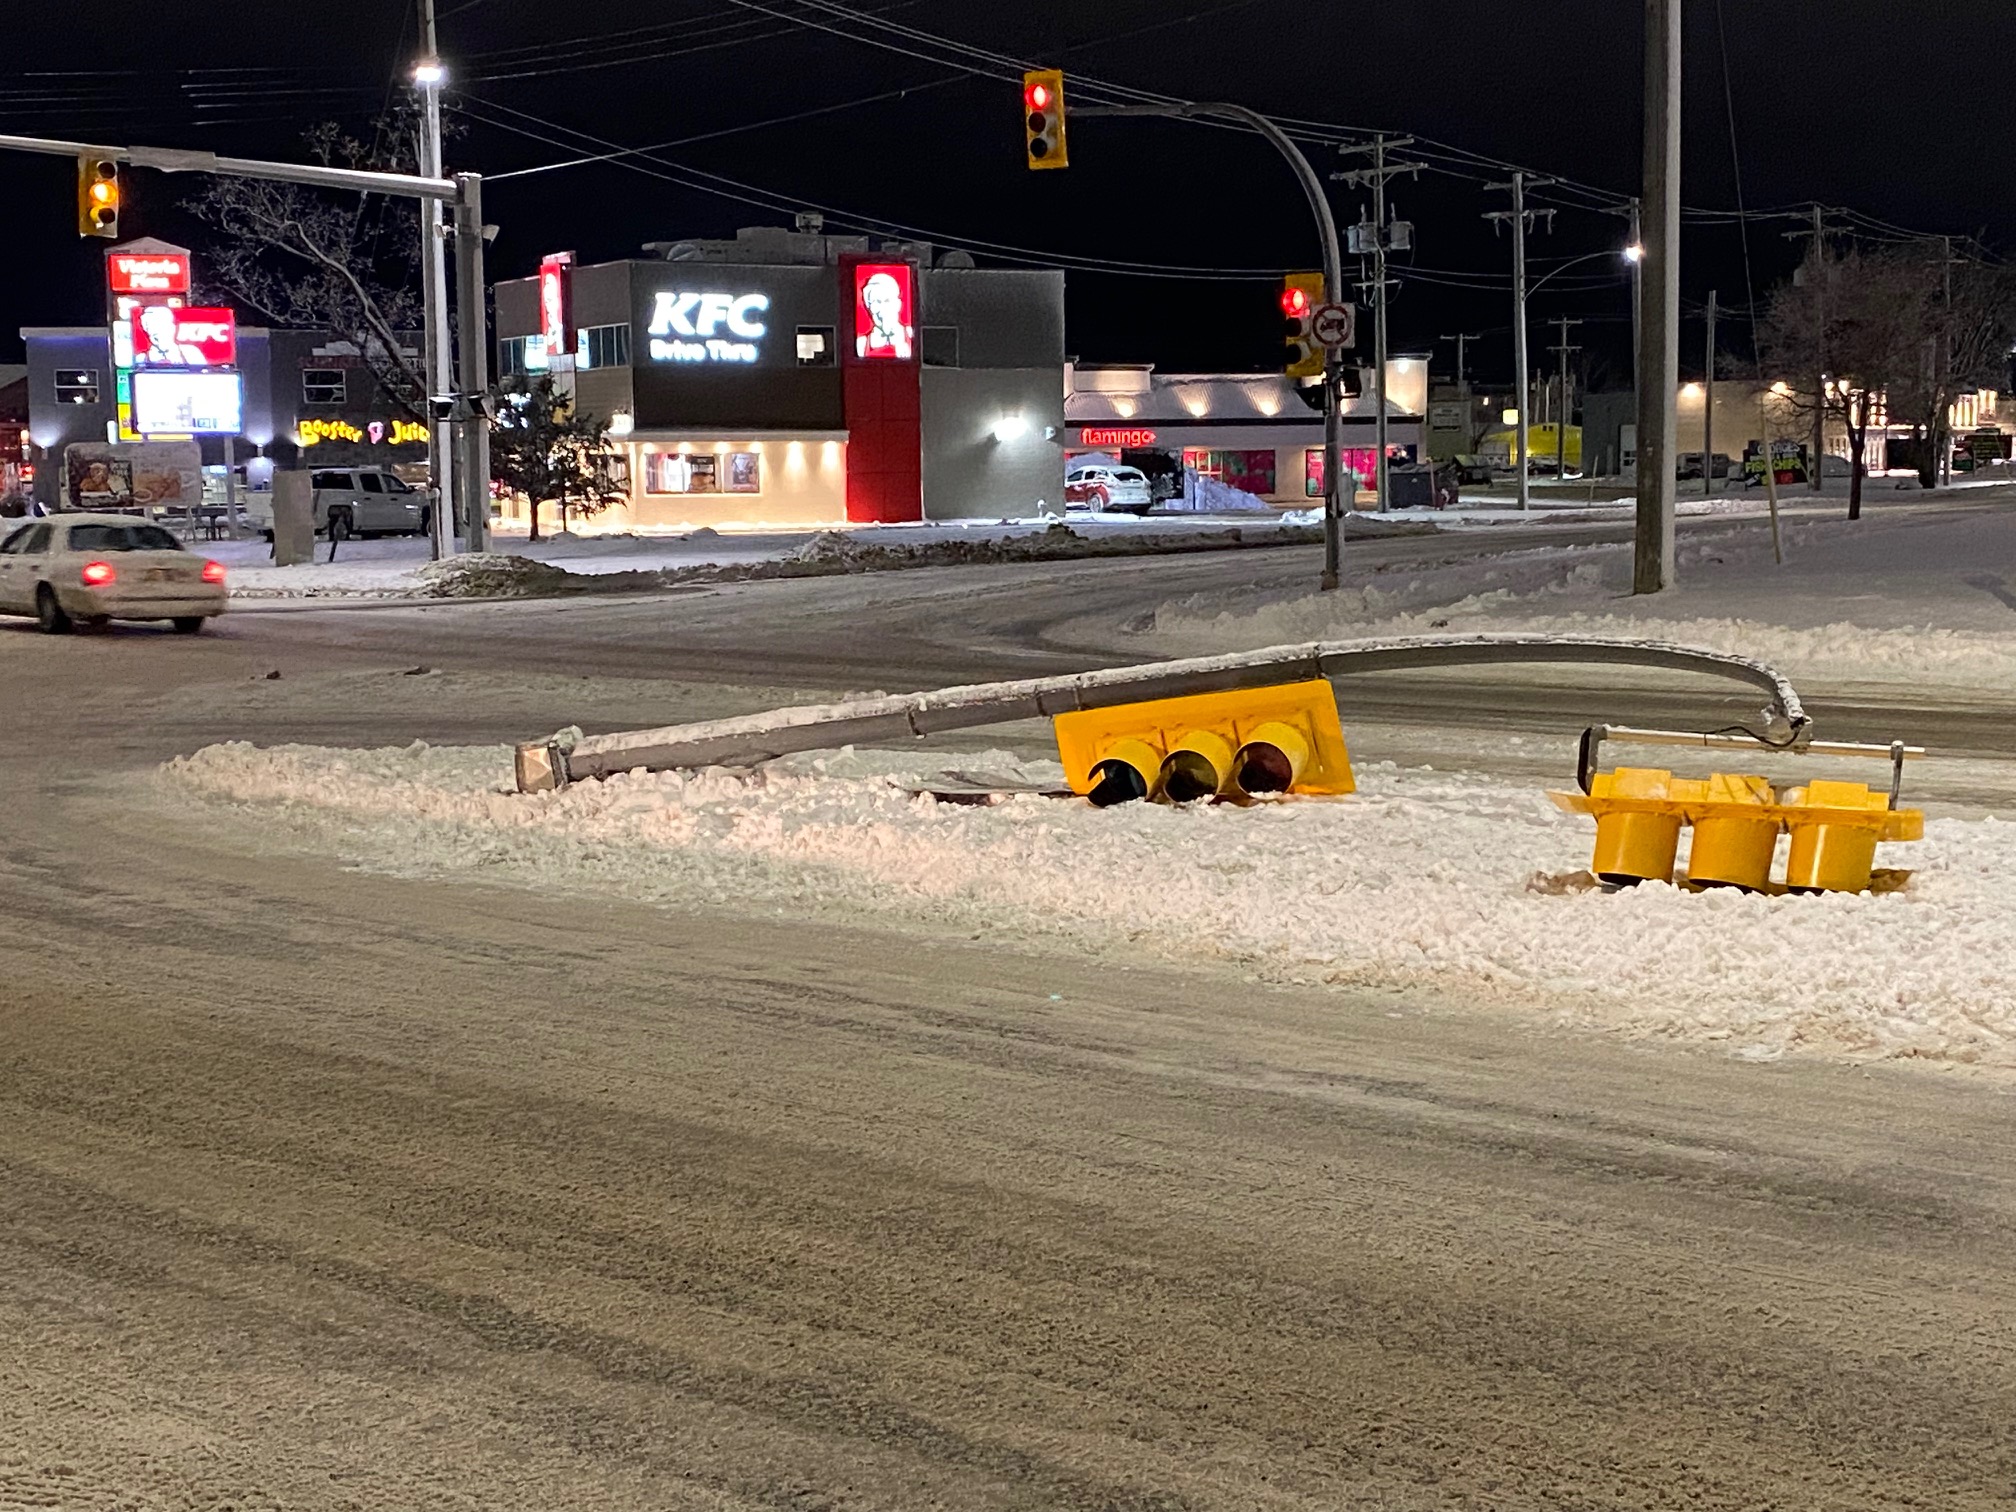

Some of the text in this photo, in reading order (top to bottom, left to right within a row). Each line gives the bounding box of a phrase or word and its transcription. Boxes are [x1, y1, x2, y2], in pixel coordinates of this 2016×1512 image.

[648, 291, 769, 338] KFC
[176, 323, 230, 342] KFC
[650, 339, 759, 361] Drive Thru
[299, 419, 430, 447] Booster Juic
[1082, 428, 1156, 447] flamingo
